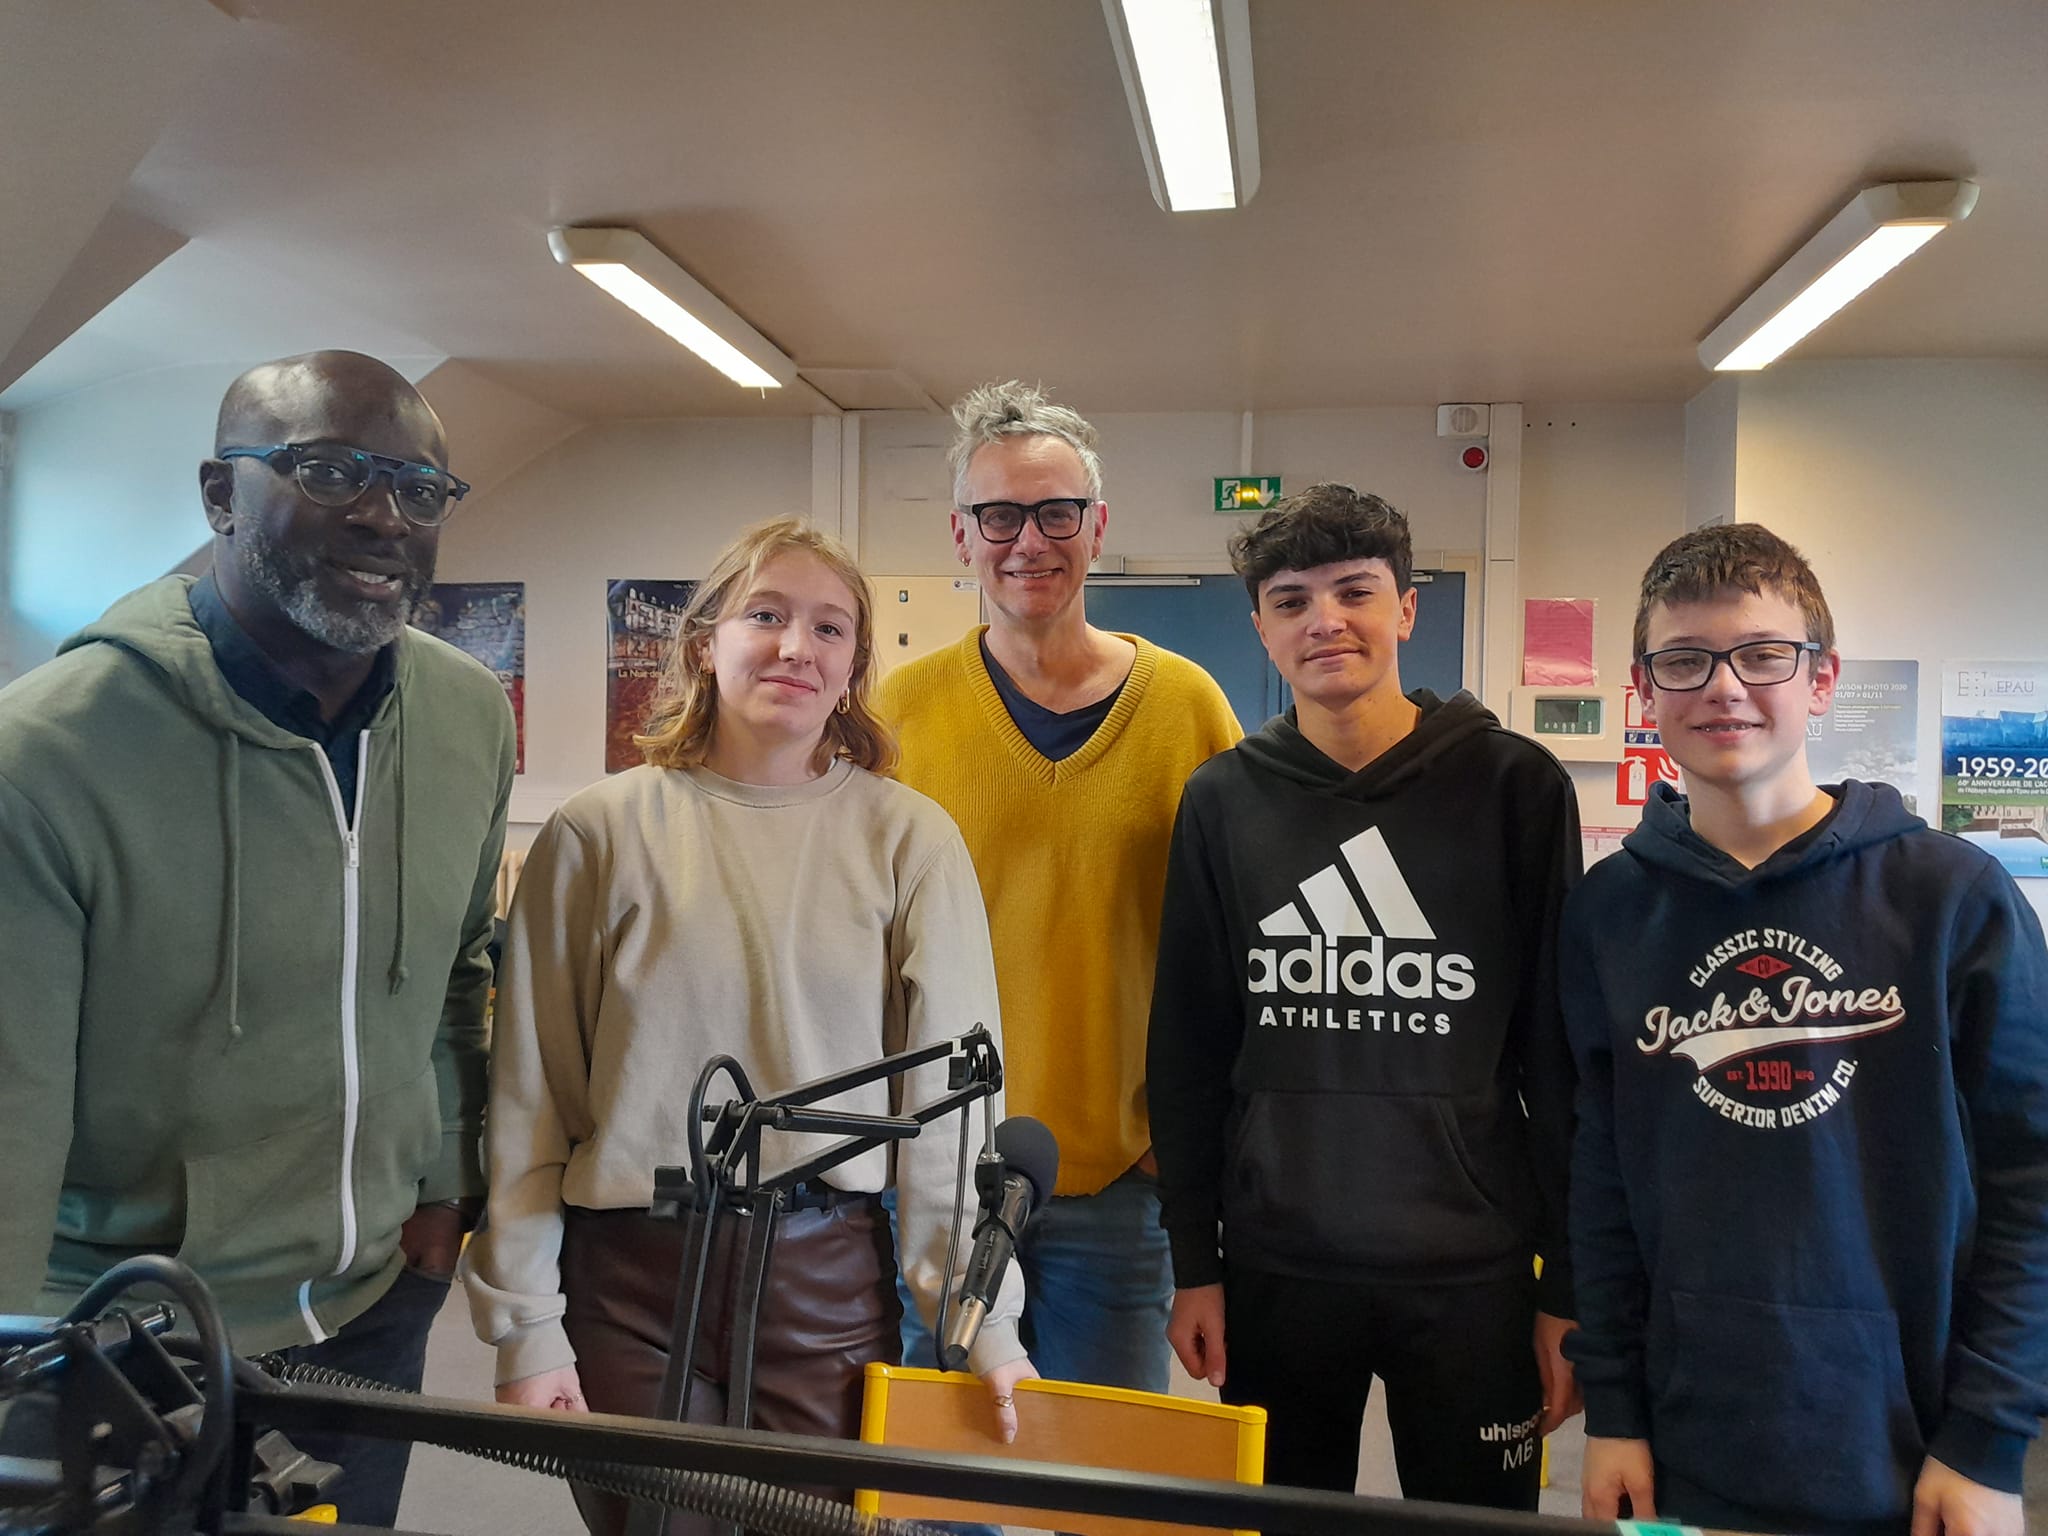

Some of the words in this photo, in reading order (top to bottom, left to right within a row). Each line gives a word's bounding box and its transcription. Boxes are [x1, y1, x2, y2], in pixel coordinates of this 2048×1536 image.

[1863, 683, 1889, 691] PHOTO
[1971, 779, 2021, 787] ANNIVERSAIRE
[2023, 780, 2033, 788] DE
[1248, 934, 1476, 1000] adidas
[1689, 929, 1758, 988] CLASSIC
[1763, 928, 1844, 982] STYLING
[1259, 1006, 1451, 1035] ATHLETICS
[1636, 992, 1738, 1053] Jack
[1738, 987, 1771, 1022] &
[1770, 975, 1903, 1024] Jones
[1692, 1075, 1776, 1128] SUPERIOR
[1780, 1083, 1841, 1127] DENIM
[1832, 1058, 1859, 1089] CO.
[1745, 1061, 1792, 1091] 1990
